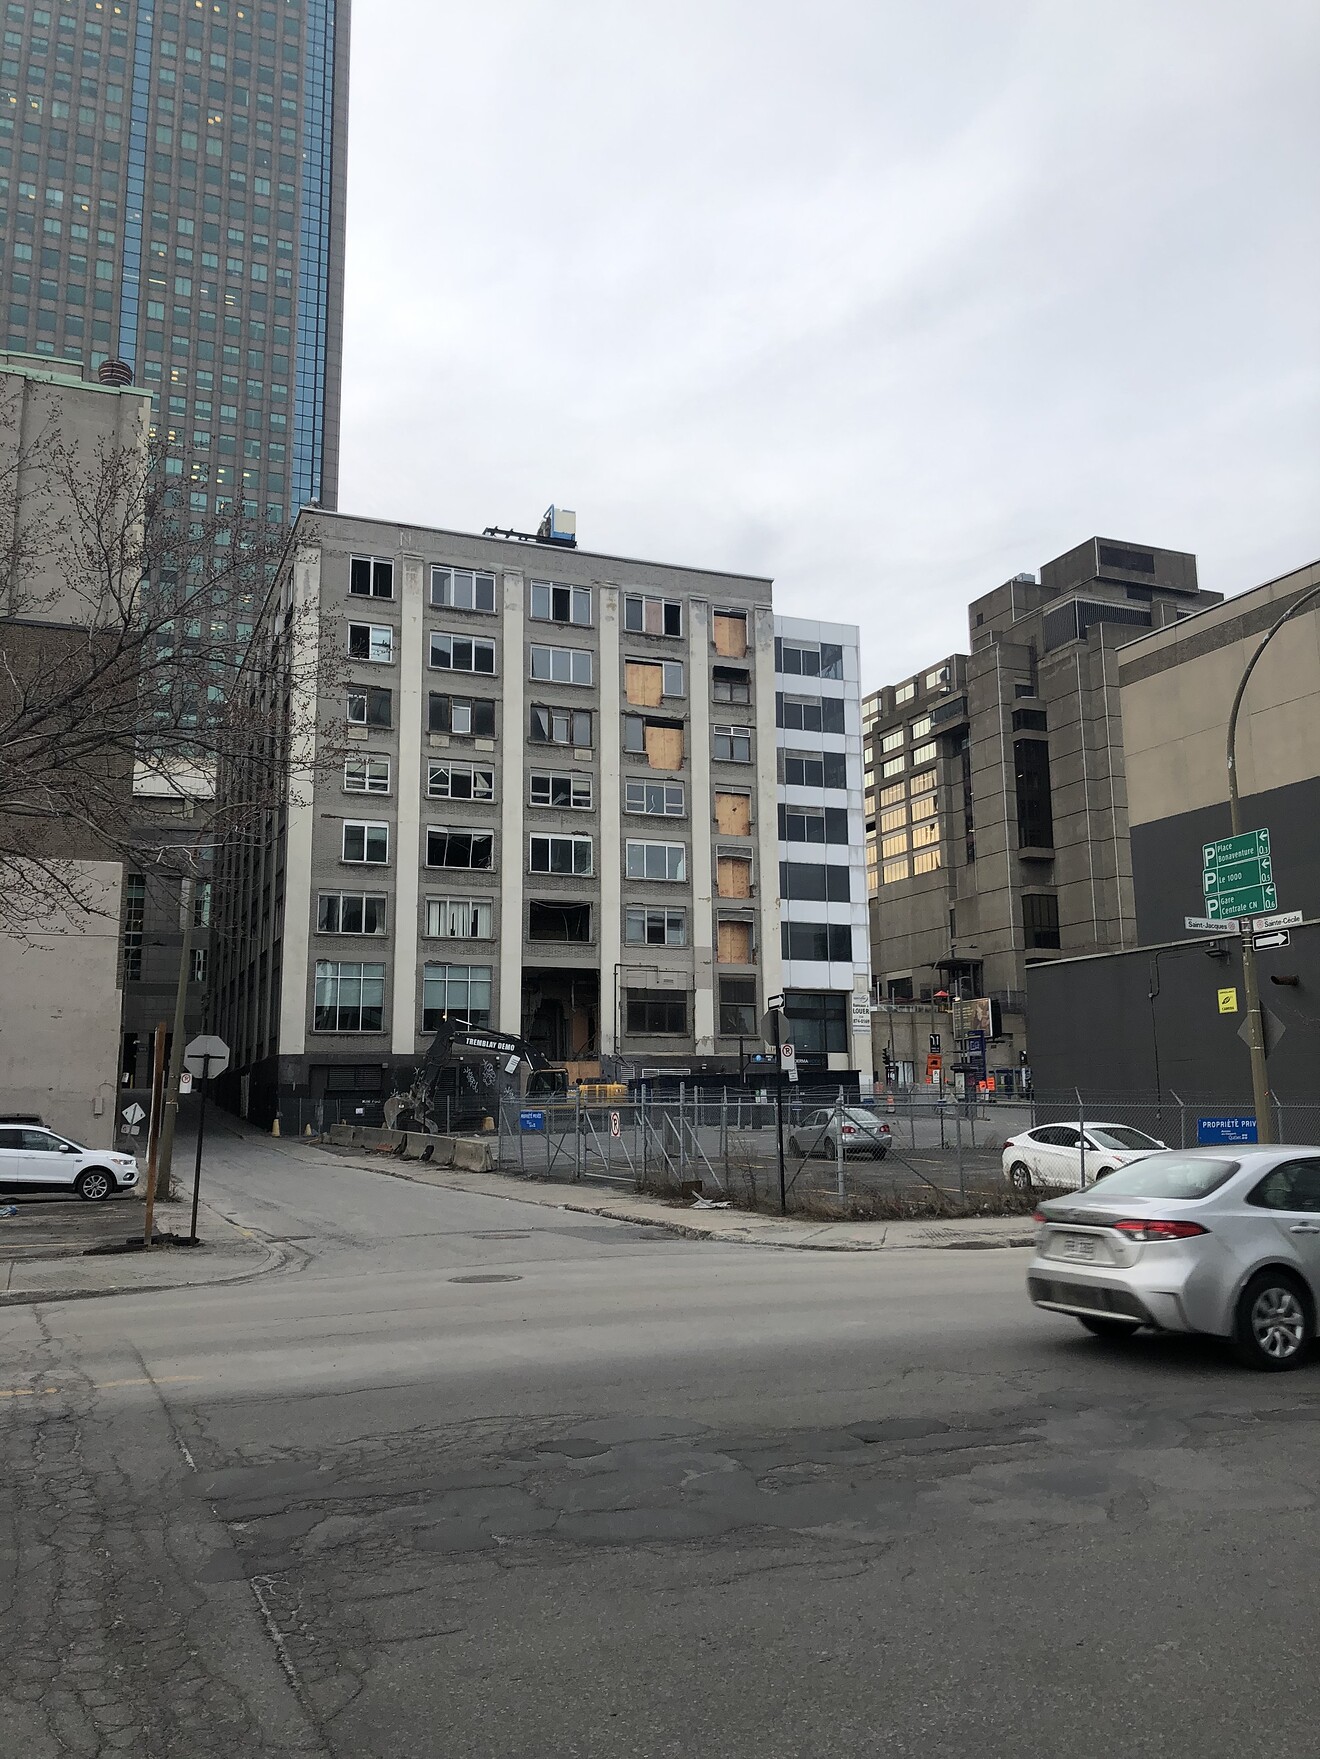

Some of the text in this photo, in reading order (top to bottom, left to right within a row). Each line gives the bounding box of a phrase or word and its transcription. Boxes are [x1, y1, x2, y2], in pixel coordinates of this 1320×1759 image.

[1217, 842, 1232, 852] Place
[1204, 847, 1215, 866] P
[1218, 847, 1254, 862] Bonaventure
[1204, 872, 1216, 891] P
[1227, 872, 1242, 881] 1000
[1220, 896, 1234, 904] Gare
[1206, 899, 1218, 918] P
[1221, 901, 1258, 914] Centrale CN
[1188, 920, 1227, 930] Saint-Jacques
[465, 1037, 515, 1051] TREMBLAY DEMO
[1202, 1118, 1239, 1128] PROPRIÉTÉ
